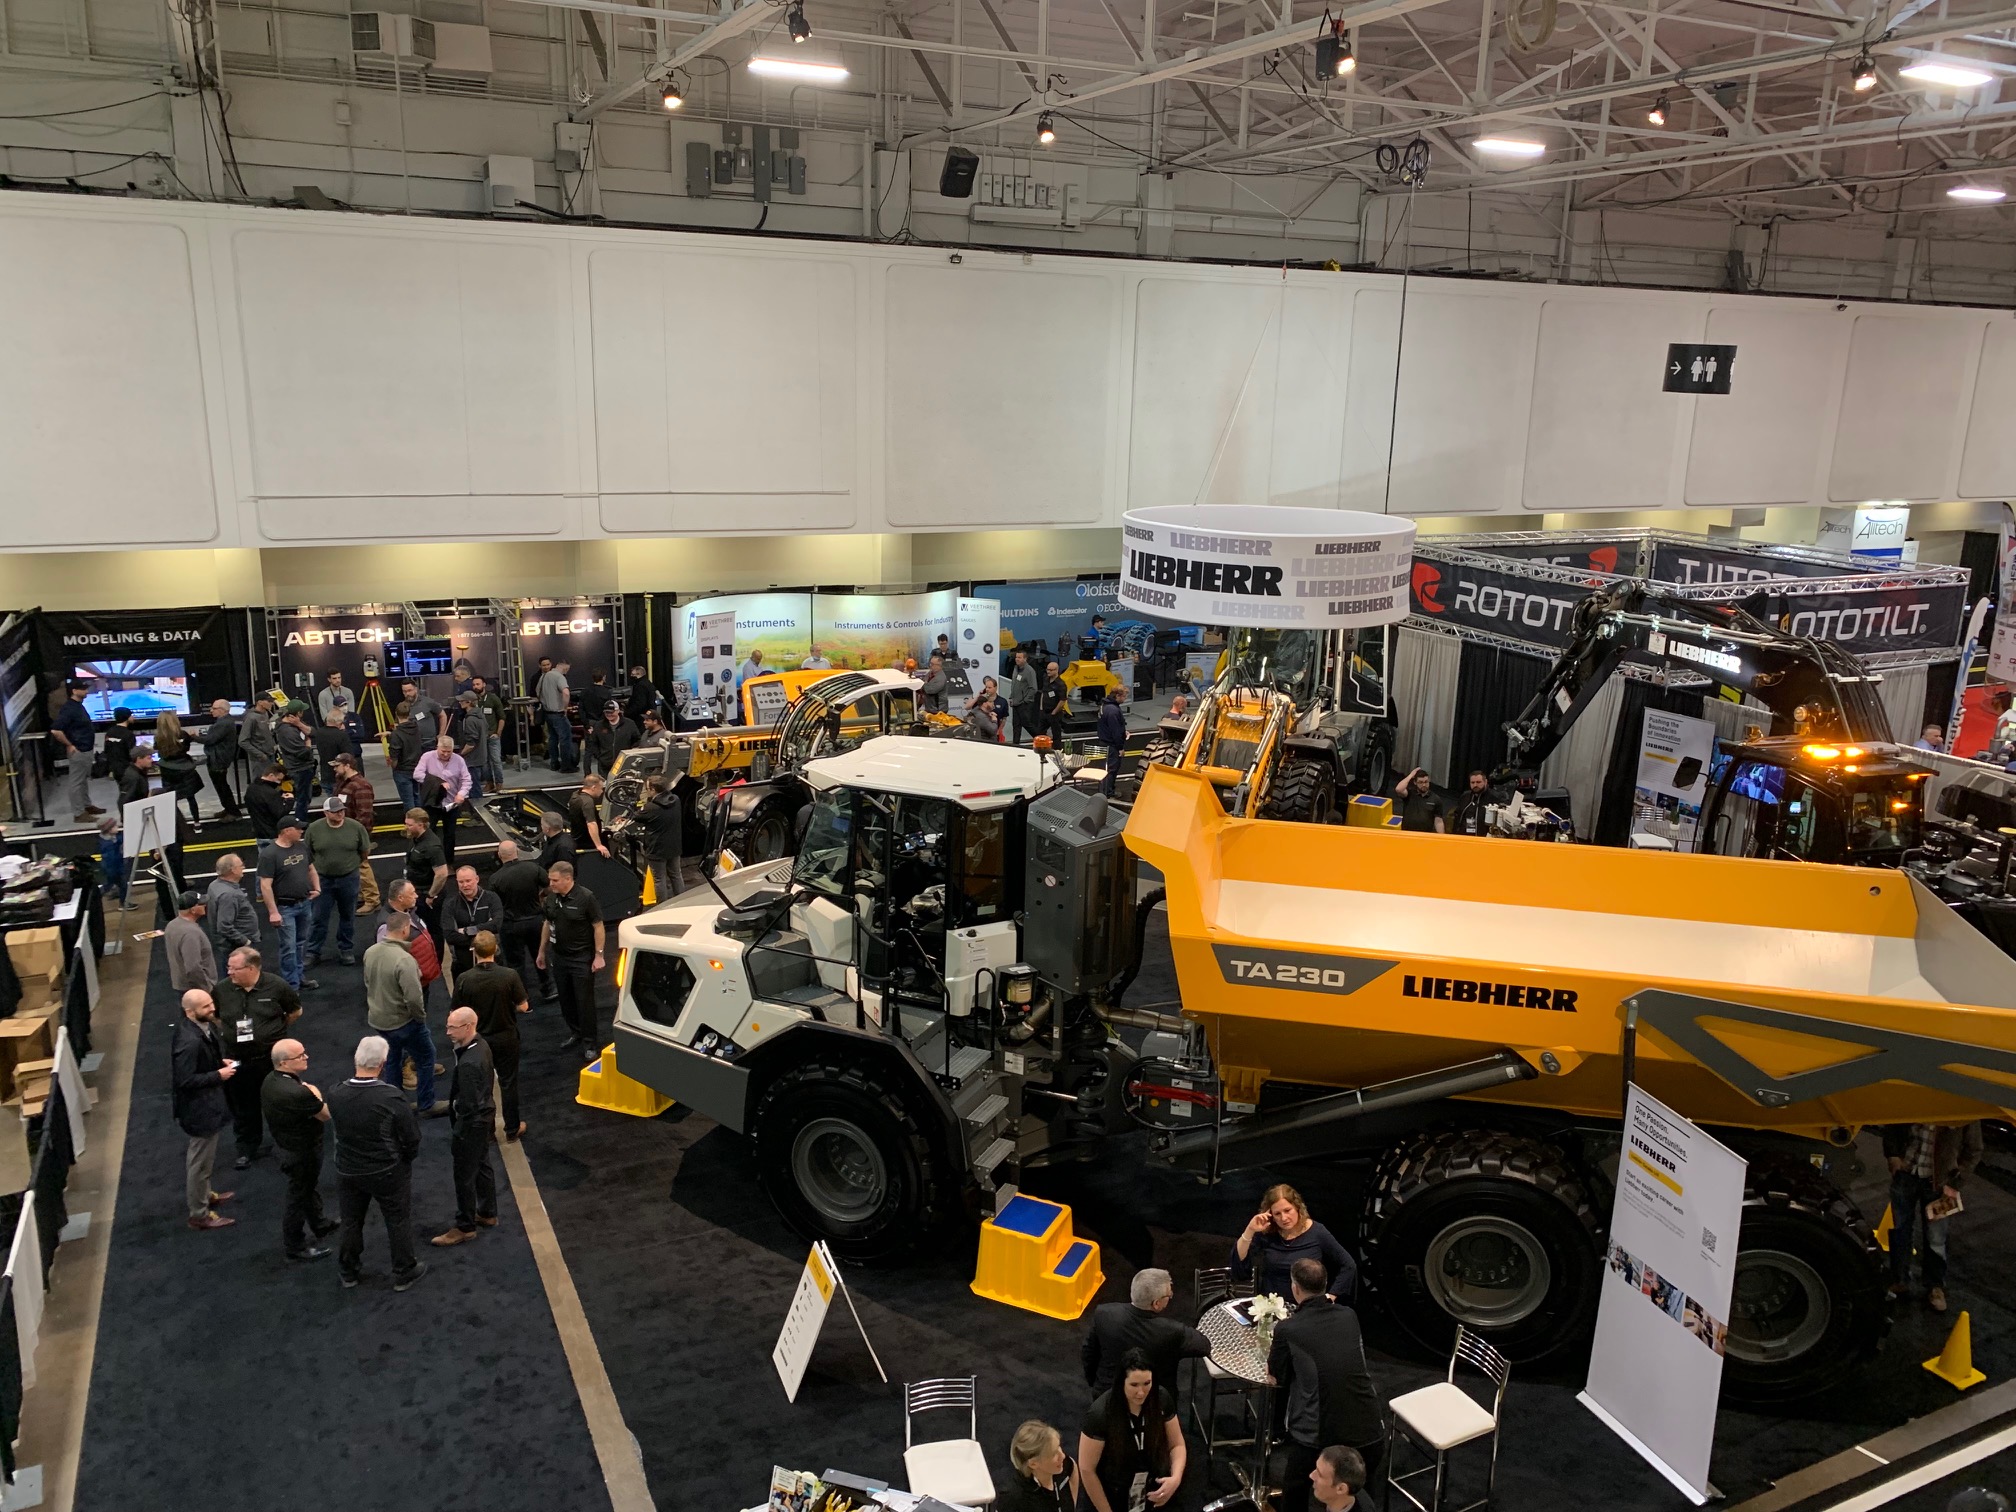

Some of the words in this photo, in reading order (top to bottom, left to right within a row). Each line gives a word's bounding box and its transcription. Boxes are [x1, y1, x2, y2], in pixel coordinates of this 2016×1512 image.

[1124, 524, 1154, 542] LIEBHERR
[1820, 521, 1851, 534] Alltech
[1856, 520, 1904, 539] Alltech
[1170, 531, 1273, 556] LIEBHERR
[1315, 540, 1382, 555] LIEBHERR
[1129, 549, 1284, 597] LIEBHERR
[1291, 553, 1396, 577] LIEBHERR
[1076, 581, 1120, 598] Olofsfo
[1121, 580, 1177, 610] LIEBHERR
[1296, 575, 1390, 598] LIEBHERR
[1056, 607, 1087, 616] Indexator
[1211, 601, 1305, 620] LIEBHERR
[1328, 595, 1394, 615] LIEBHERR
[1454, 580, 1574, 632] ROTOT
[736, 618, 796, 629] nstruments
[834, 621, 884, 630] Instruments
[885, 621, 892, 629] &
[893, 619, 924, 629] Controls
[924, 618, 933, 626] for
[934, 615, 954, 625] Industry
[1770, 603, 1929, 641] OTOTILT
[63, 632, 144, 646] MODELING
[148, 631, 159, 642] &
[163, 630, 201, 642] DATA
[284, 627, 395, 647] ABTECH
[1669, 640, 1742, 674] LIEBHERR
[1648, 723, 1677, 735] Boundaries
[1649, 716, 1669, 727] Pushing
[1671, 721, 1679, 729] the
[1645, 742, 1674, 753] LIEBHERR
[1402, 974, 1579, 1013] LIEBHERR
[1635, 1105, 1646, 1117] One
[1646, 1112, 1669, 1134] Passion.
[1634, 1115, 1649, 1131] Many
[1649, 1125, 1688, 1159] Opportunities.
[1630, 1134, 1677, 1174] LIEBHERR
[1626, 1169, 1636, 1179] Start
[1641, 1182, 1659, 1199] exciting
[1659, 1194, 1673, 1207] career
